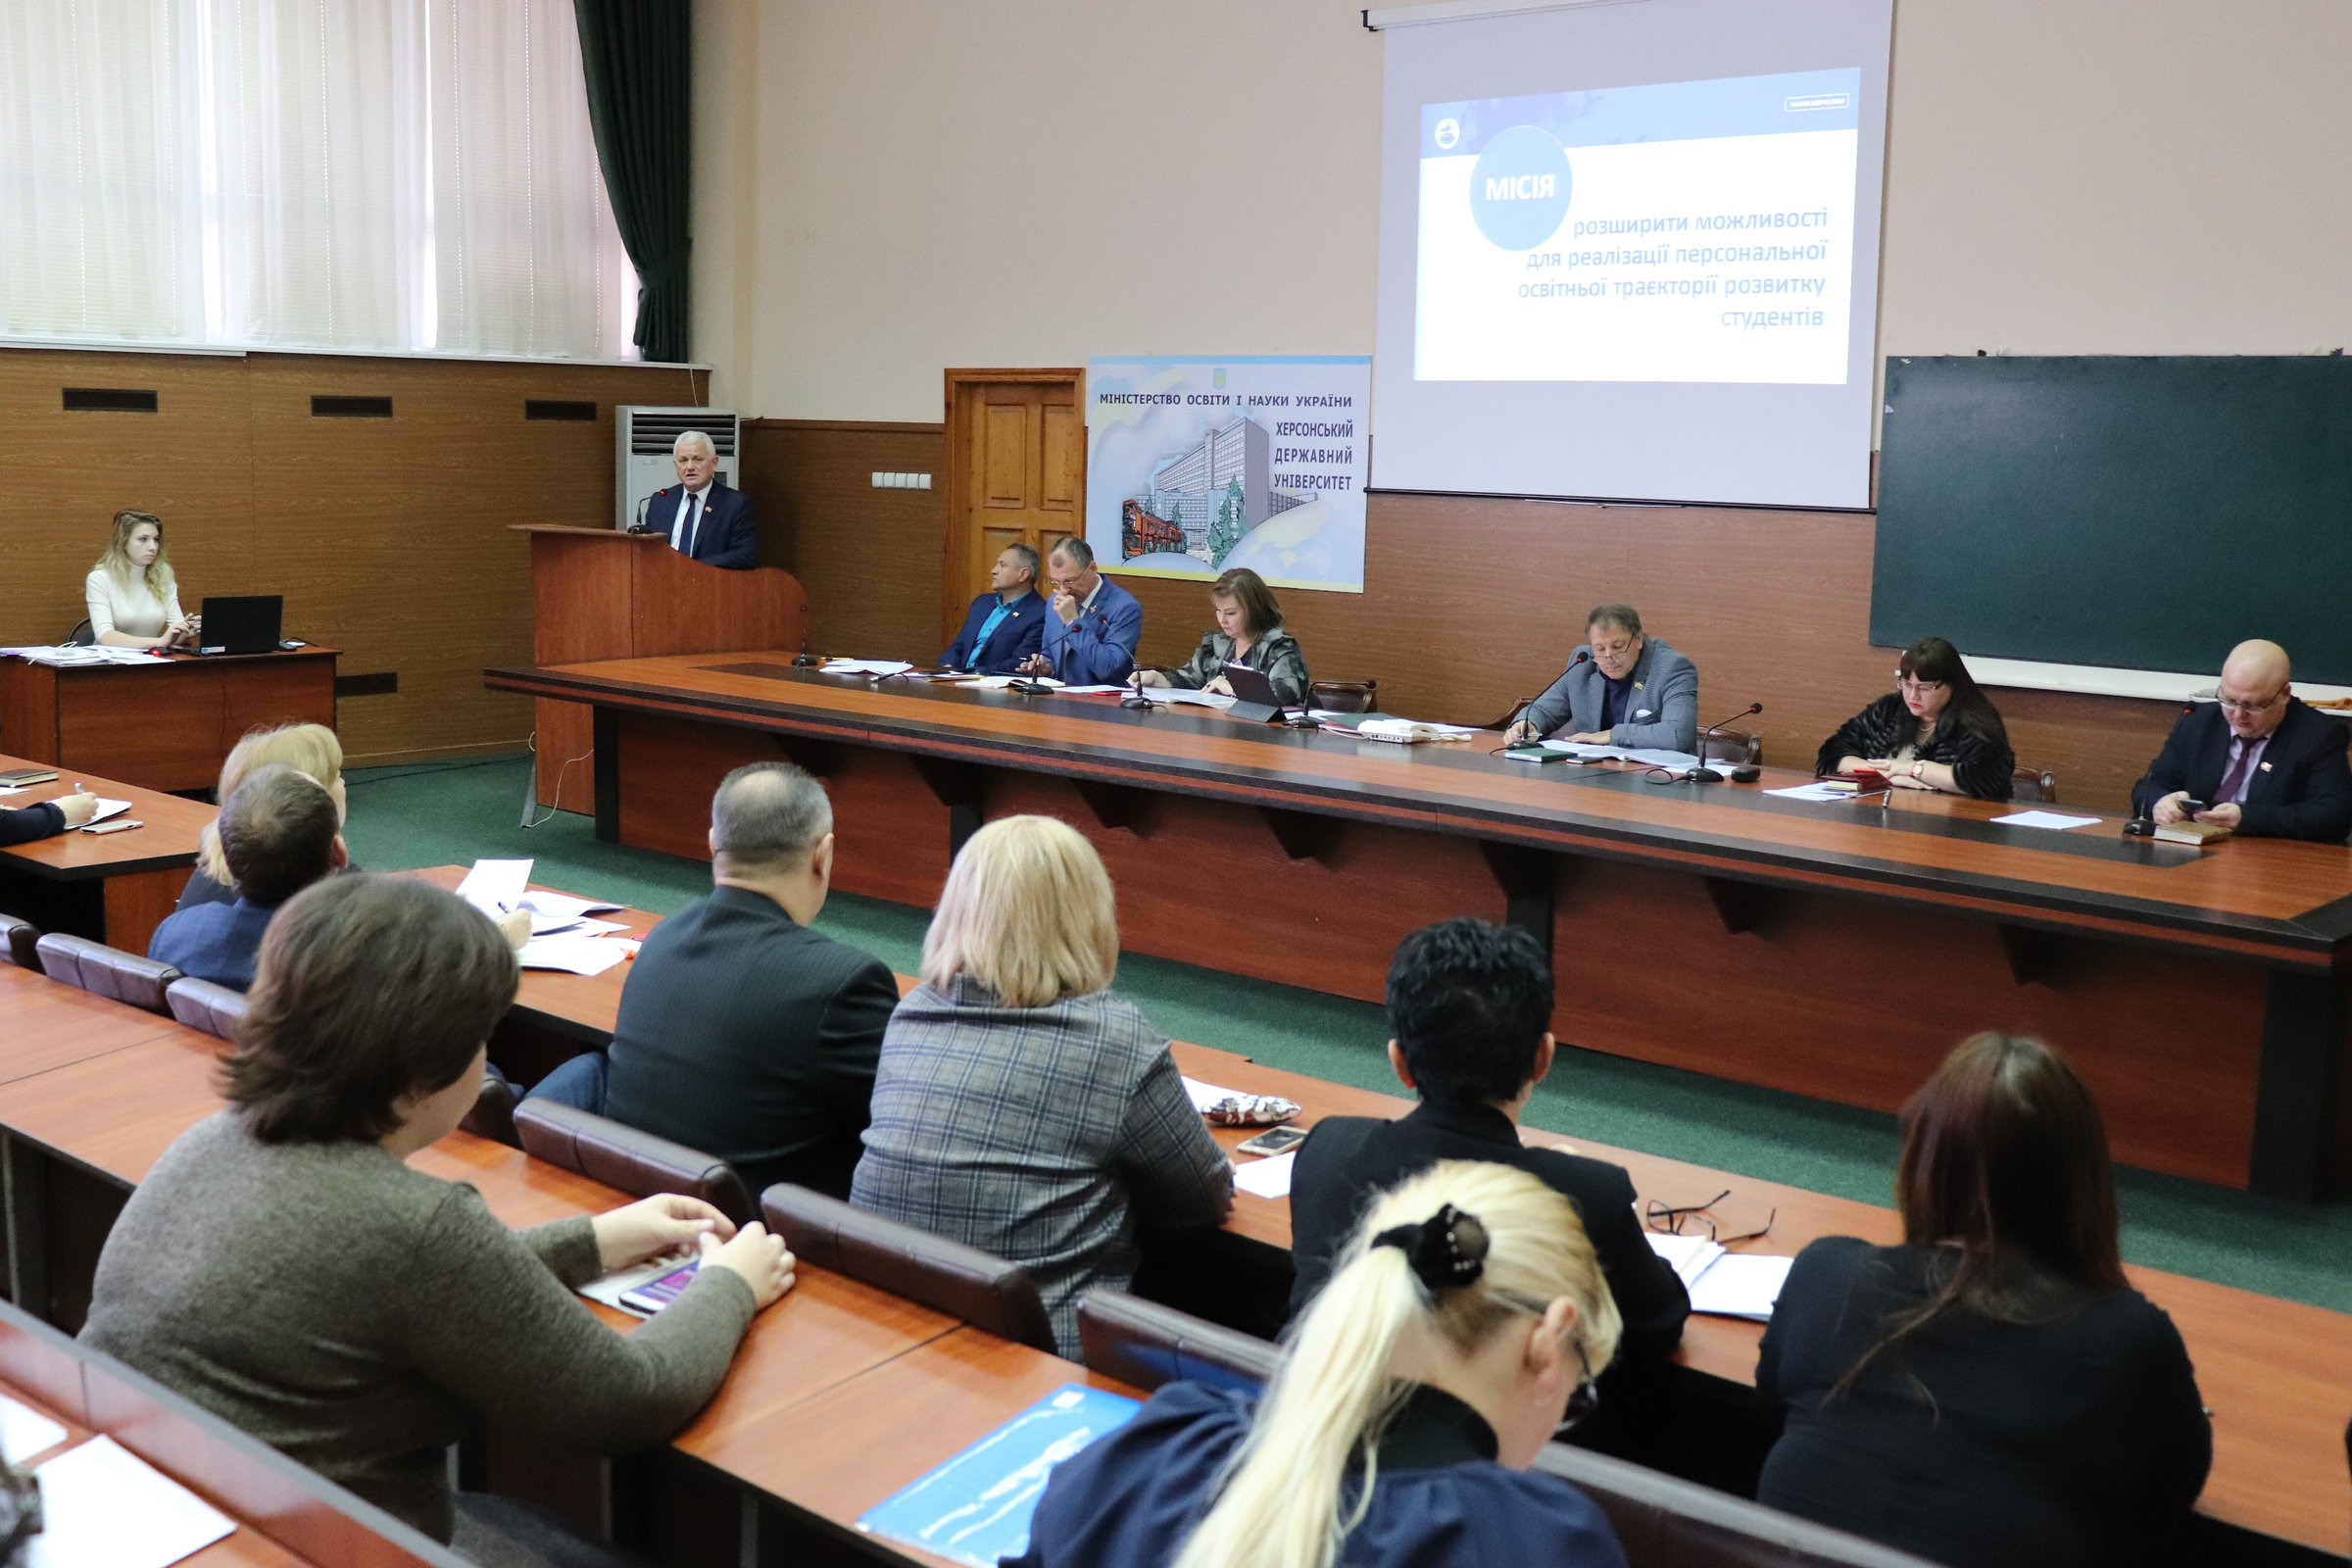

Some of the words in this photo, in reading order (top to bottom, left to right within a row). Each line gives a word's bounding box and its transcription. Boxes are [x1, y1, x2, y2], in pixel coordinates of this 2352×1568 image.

[1486, 173, 1555, 201] МІСІЯ
[1573, 216, 1689, 240] розширити
[1695, 207, 1829, 231] можливості
[1526, 252, 1561, 271] для
[1568, 244, 1669, 270] реалізації
[1676, 240, 1829, 266] персональної
[1518, 278, 1607, 298] освітньої
[1613, 274, 1718, 300] траєкторії
[1725, 277, 1826, 299] розвитку
[1721, 307, 1824, 330] студентів
[1100, 393, 1181, 405] МІНІСТЕРСТВО
[1187, 394, 1230, 406] ОСВІТИ
[1236, 396, 1242, 406] І
[1249, 396, 1289, 407] НАУКИ
[1296, 394, 1352, 408] УКРАЇНИ
[1276, 419, 1353, 438] ХЕРСОНСЬКИЙ
[1274, 446, 1352, 465] ДЕРЖАВНИЙ
[1274, 473, 1351, 490] УНІВЕРСИТЕТ
